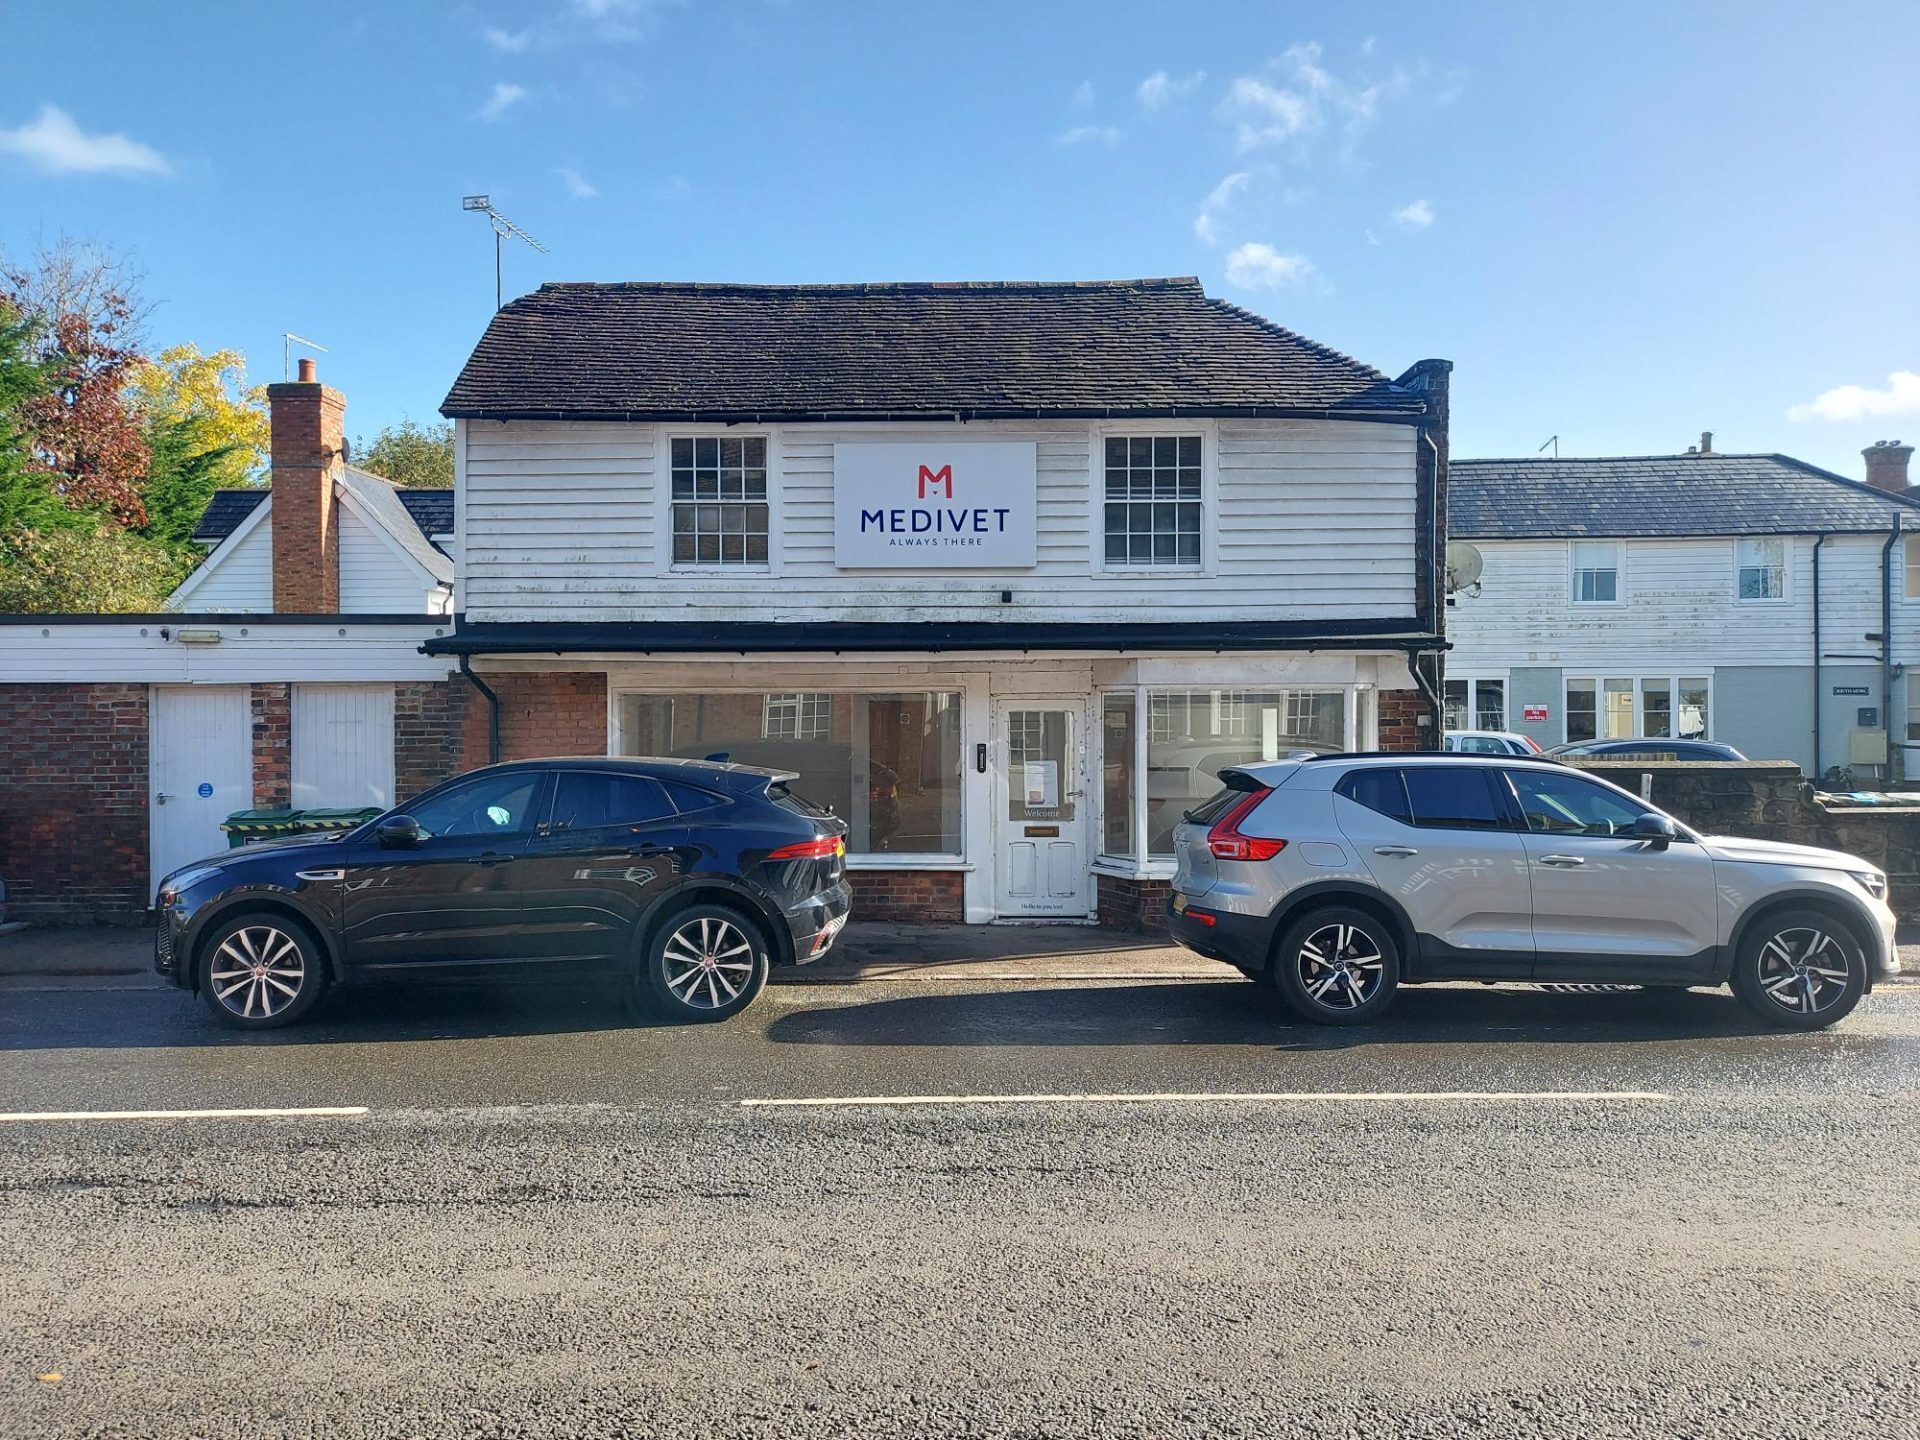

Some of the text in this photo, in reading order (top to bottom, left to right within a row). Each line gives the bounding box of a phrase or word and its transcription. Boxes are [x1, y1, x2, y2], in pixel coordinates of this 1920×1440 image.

[918, 464, 952, 499] M
[860, 509, 1010, 532] MEDIVET
[889, 538, 983, 546] ALWAYS THERE
[1024, 809, 1061, 817] Welcome
